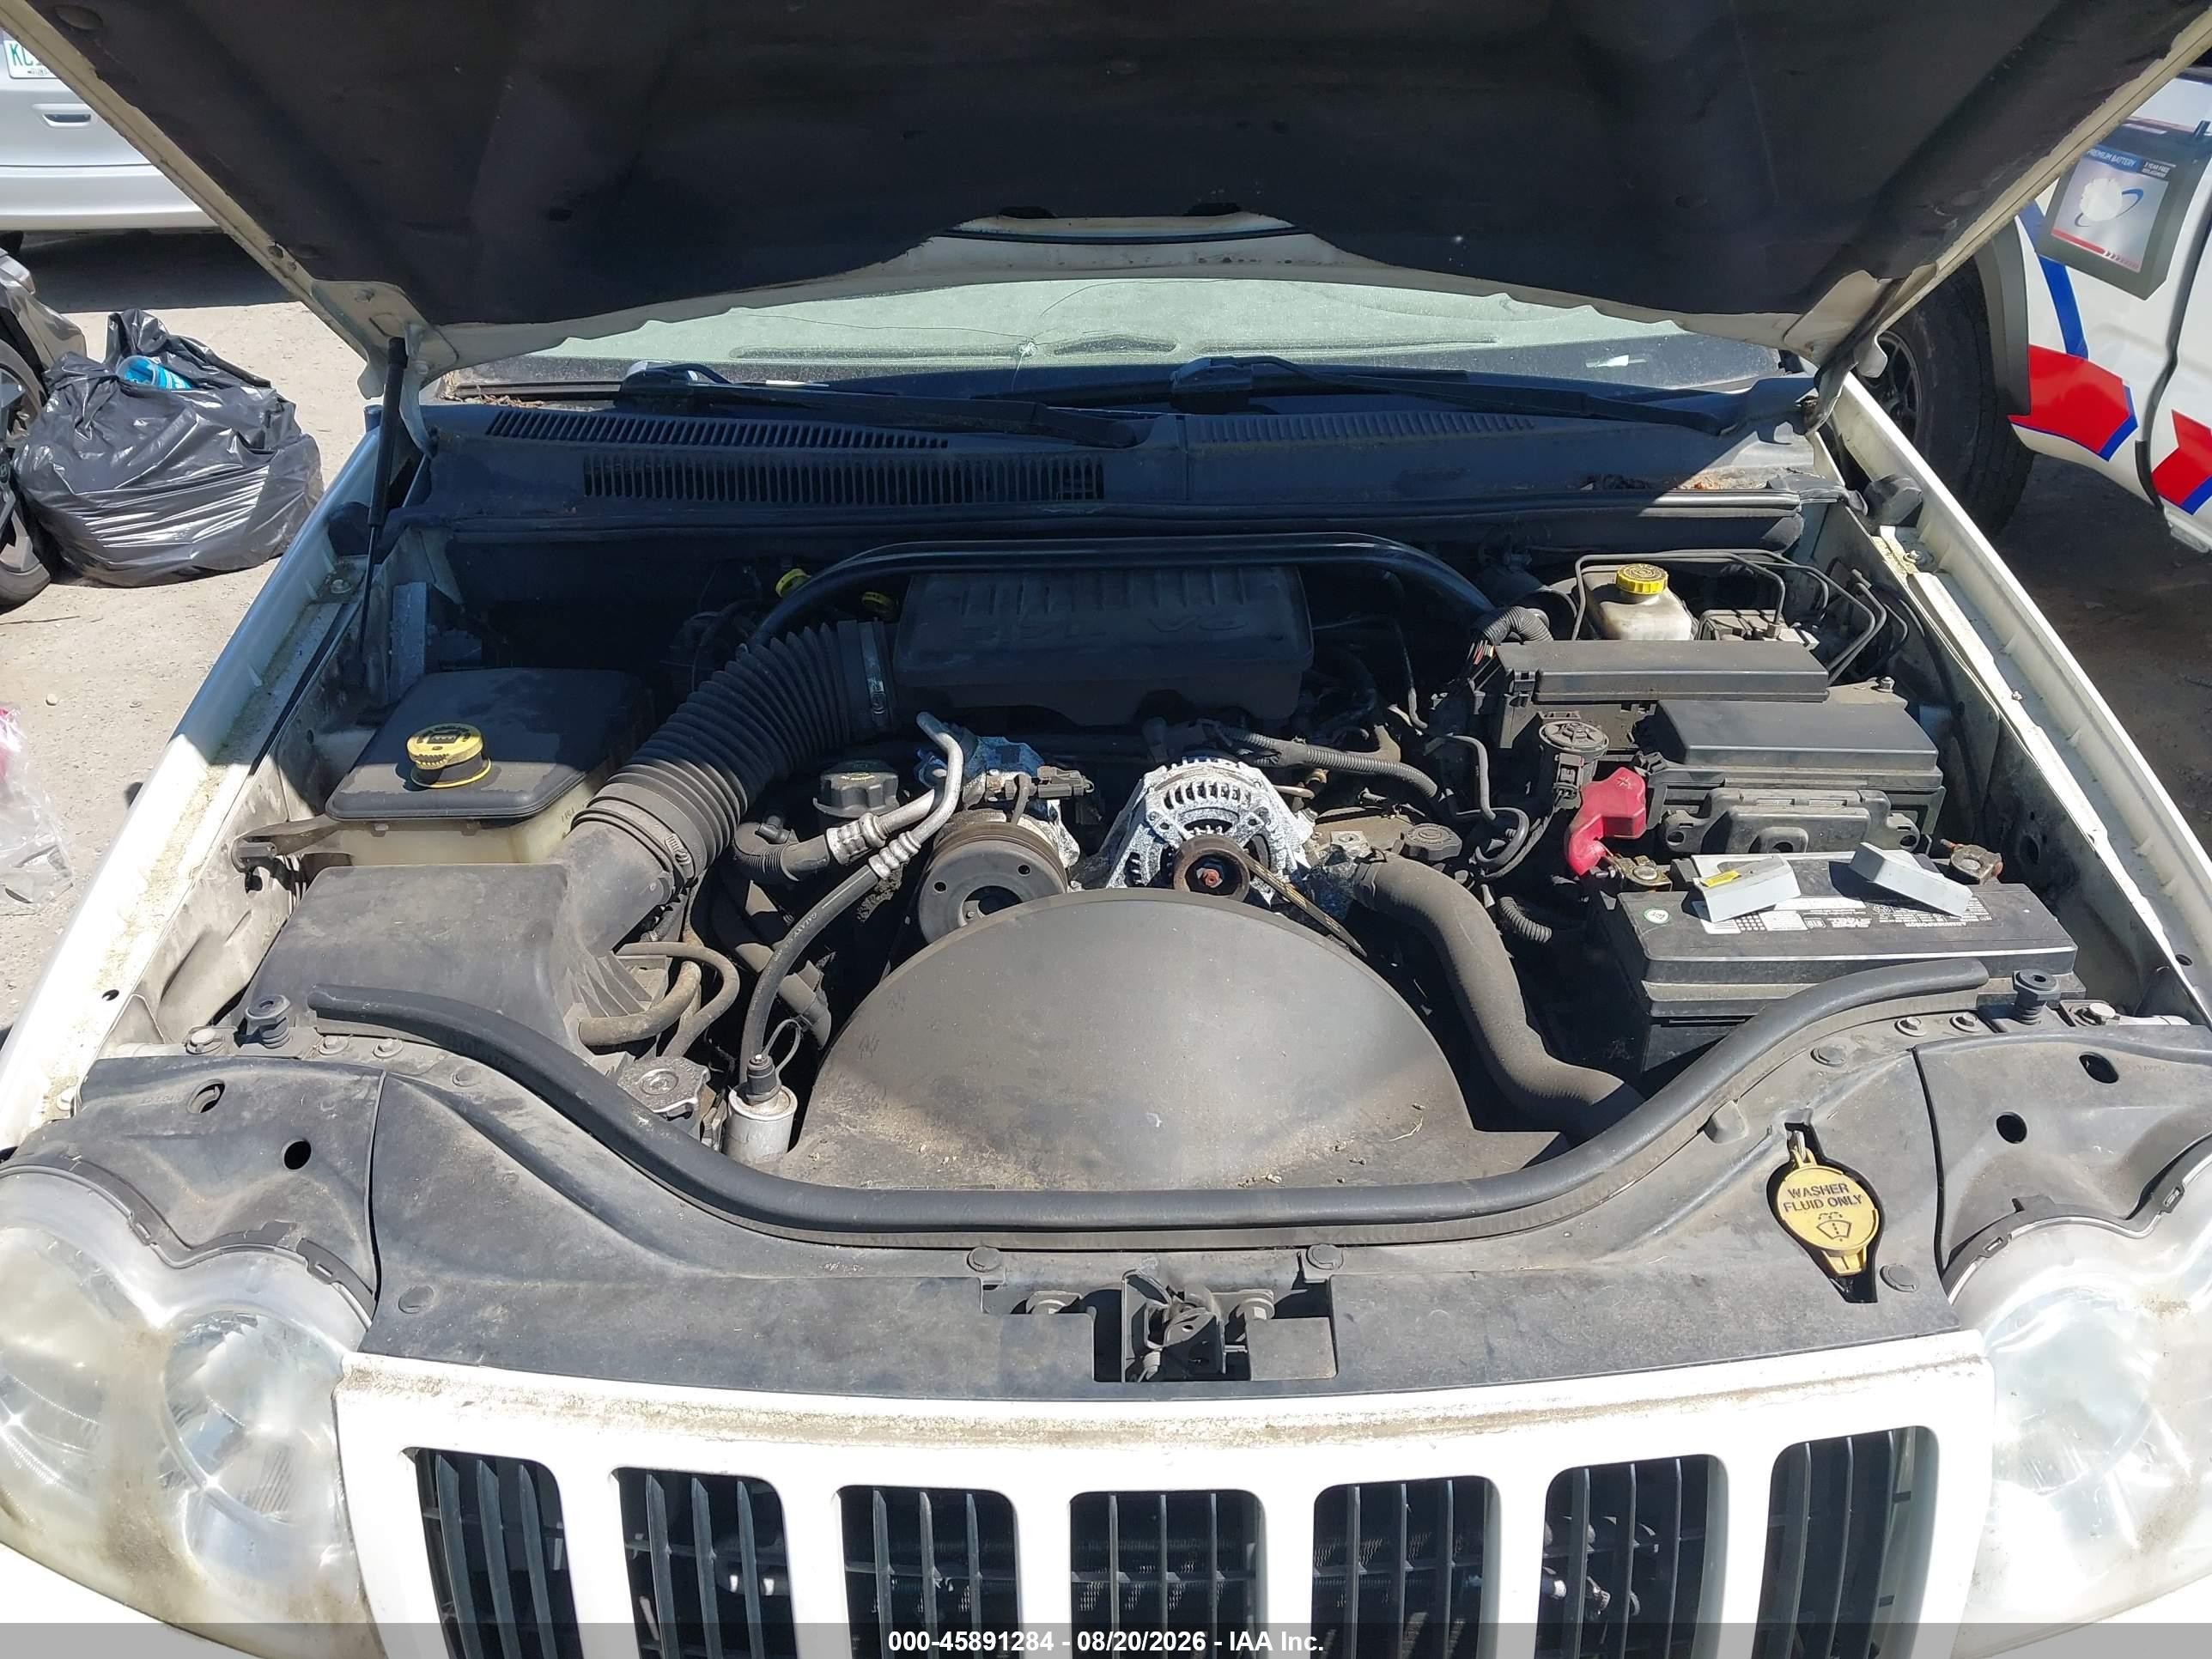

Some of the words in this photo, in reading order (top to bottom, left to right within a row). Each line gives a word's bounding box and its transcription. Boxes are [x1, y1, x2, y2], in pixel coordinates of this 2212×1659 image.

[2111, 154, 2137, 167] BATTERY
[1787, 1182, 1850, 1199] WASHER
[1783, 1199, 1824, 1212] FLUID
[1826, 1194, 1863, 1207] ONLY
